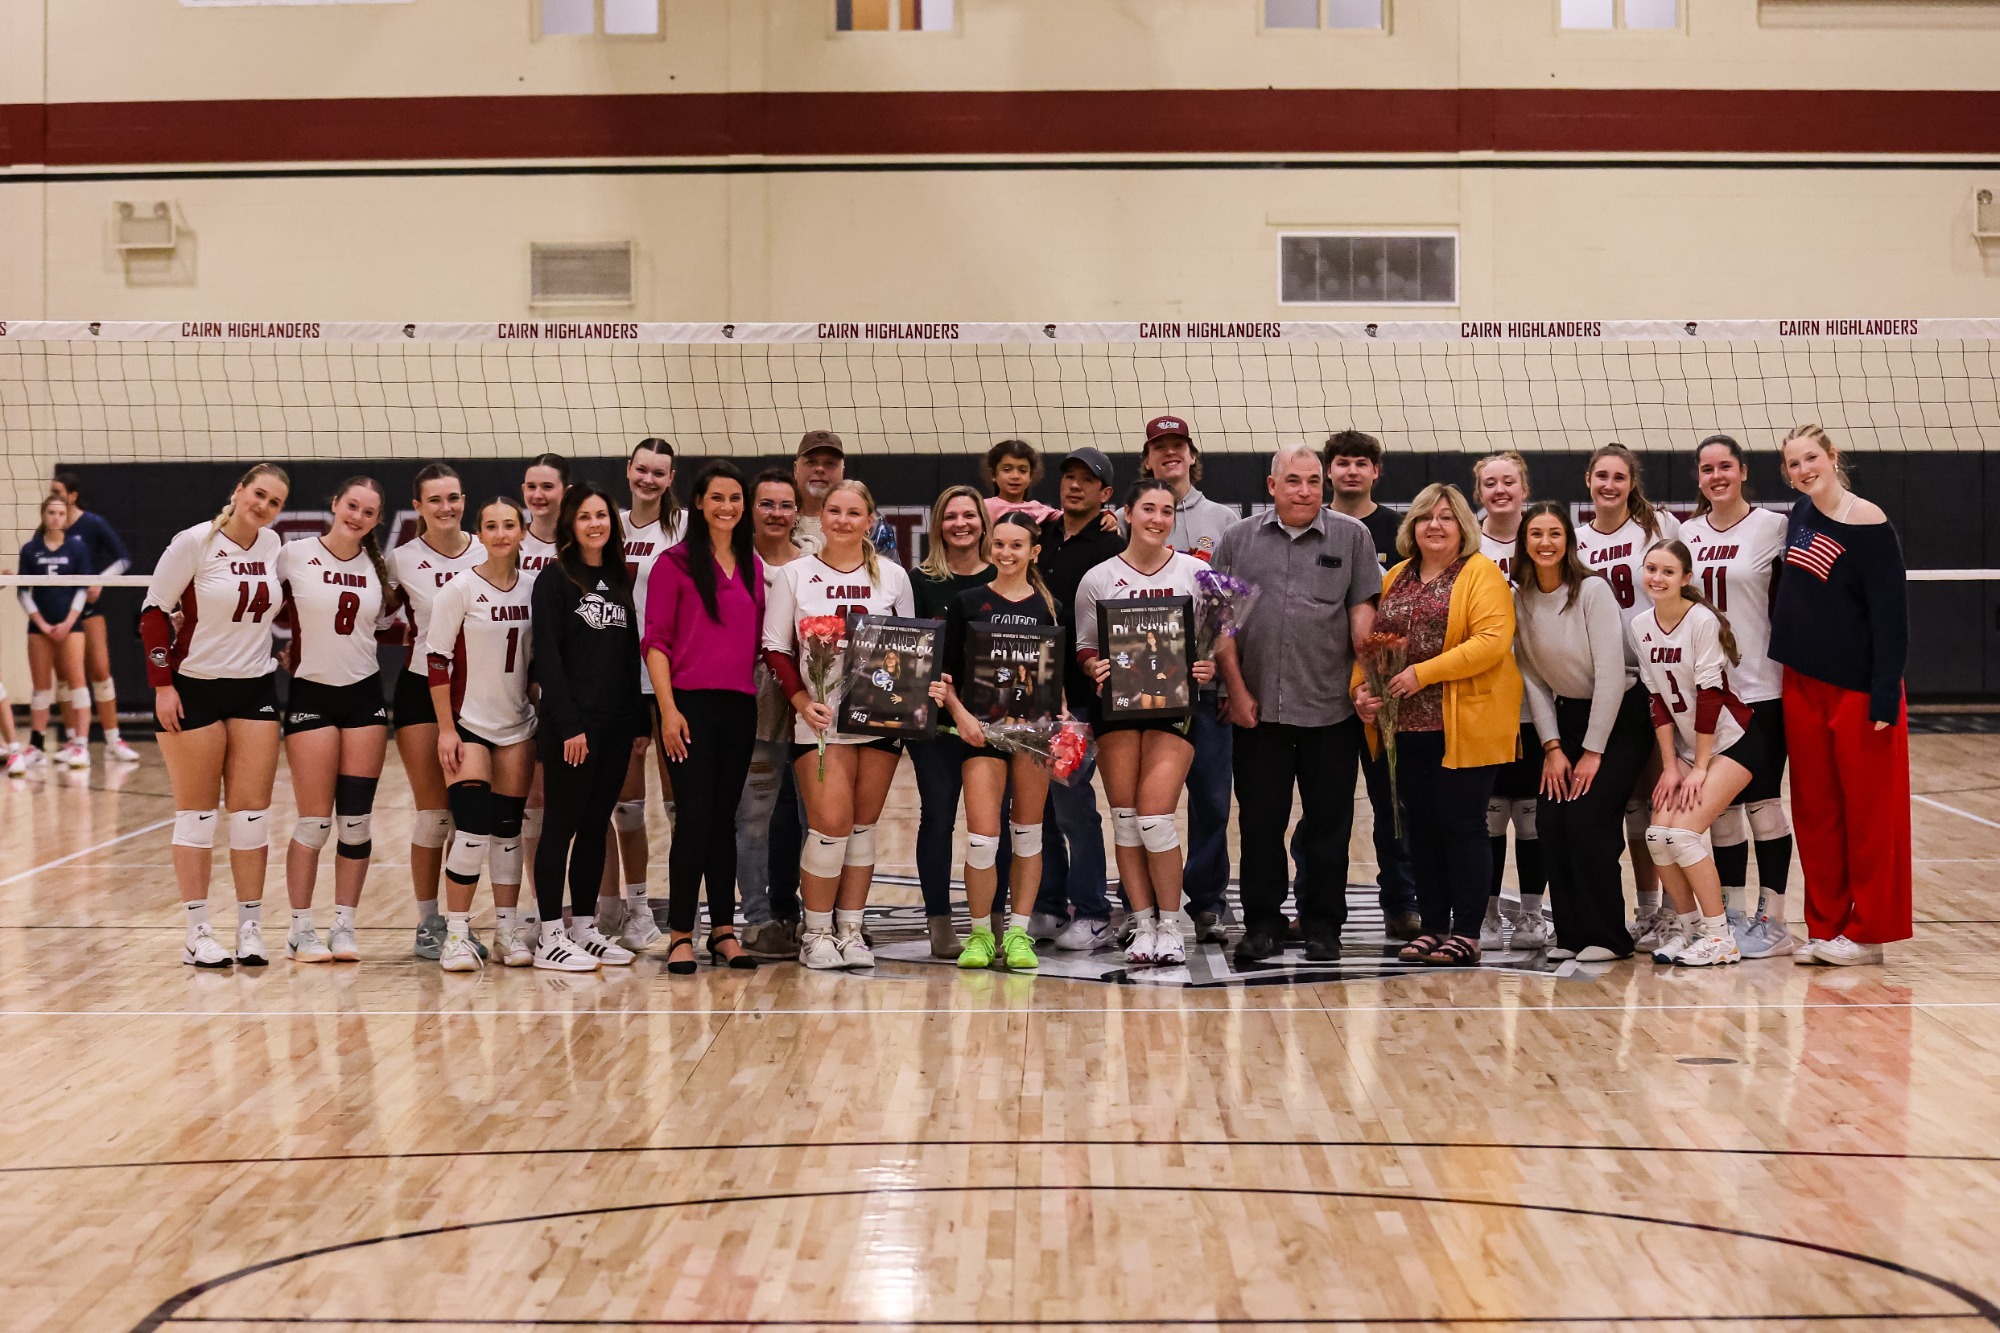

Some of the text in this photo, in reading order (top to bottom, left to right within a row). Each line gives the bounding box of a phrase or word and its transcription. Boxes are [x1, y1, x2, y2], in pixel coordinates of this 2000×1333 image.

[181, 322, 320, 337] CAIRN HIGHLANDERS
[498, 323, 638, 338] CAIRN HIGHLANDERS
[817, 323, 959, 338] CAIRN HIGHLANDERS
[1139, 322, 1281, 338] CAIRN HIGHLANDERS
[1461, 321, 1601, 337] CAIRN HIGHLANDERS
[1779, 320, 1918, 335] CAIRN HIGHLANDERS
[625, 541, 656, 556] AIRN
[1589, 542, 1633, 565] CAIRN
[1697, 544, 1740, 562] CAIRN
[230, 561, 267, 576] CAIRN
[323, 570, 367, 589] CAIRN
[1597, 564, 1636, 609] 8
[826, 585, 871, 600] CAIRN
[232, 581, 272, 623] 14
[335, 591, 360, 636] 8
[491, 605, 529, 621] CAIRN
[602, 603, 627, 624] CAIR
[504, 627, 519, 673] 1
[1650, 647, 1682, 663] CAIRN
[1665, 670, 1688, 714] 3
[851, 710, 868, 723] #13
